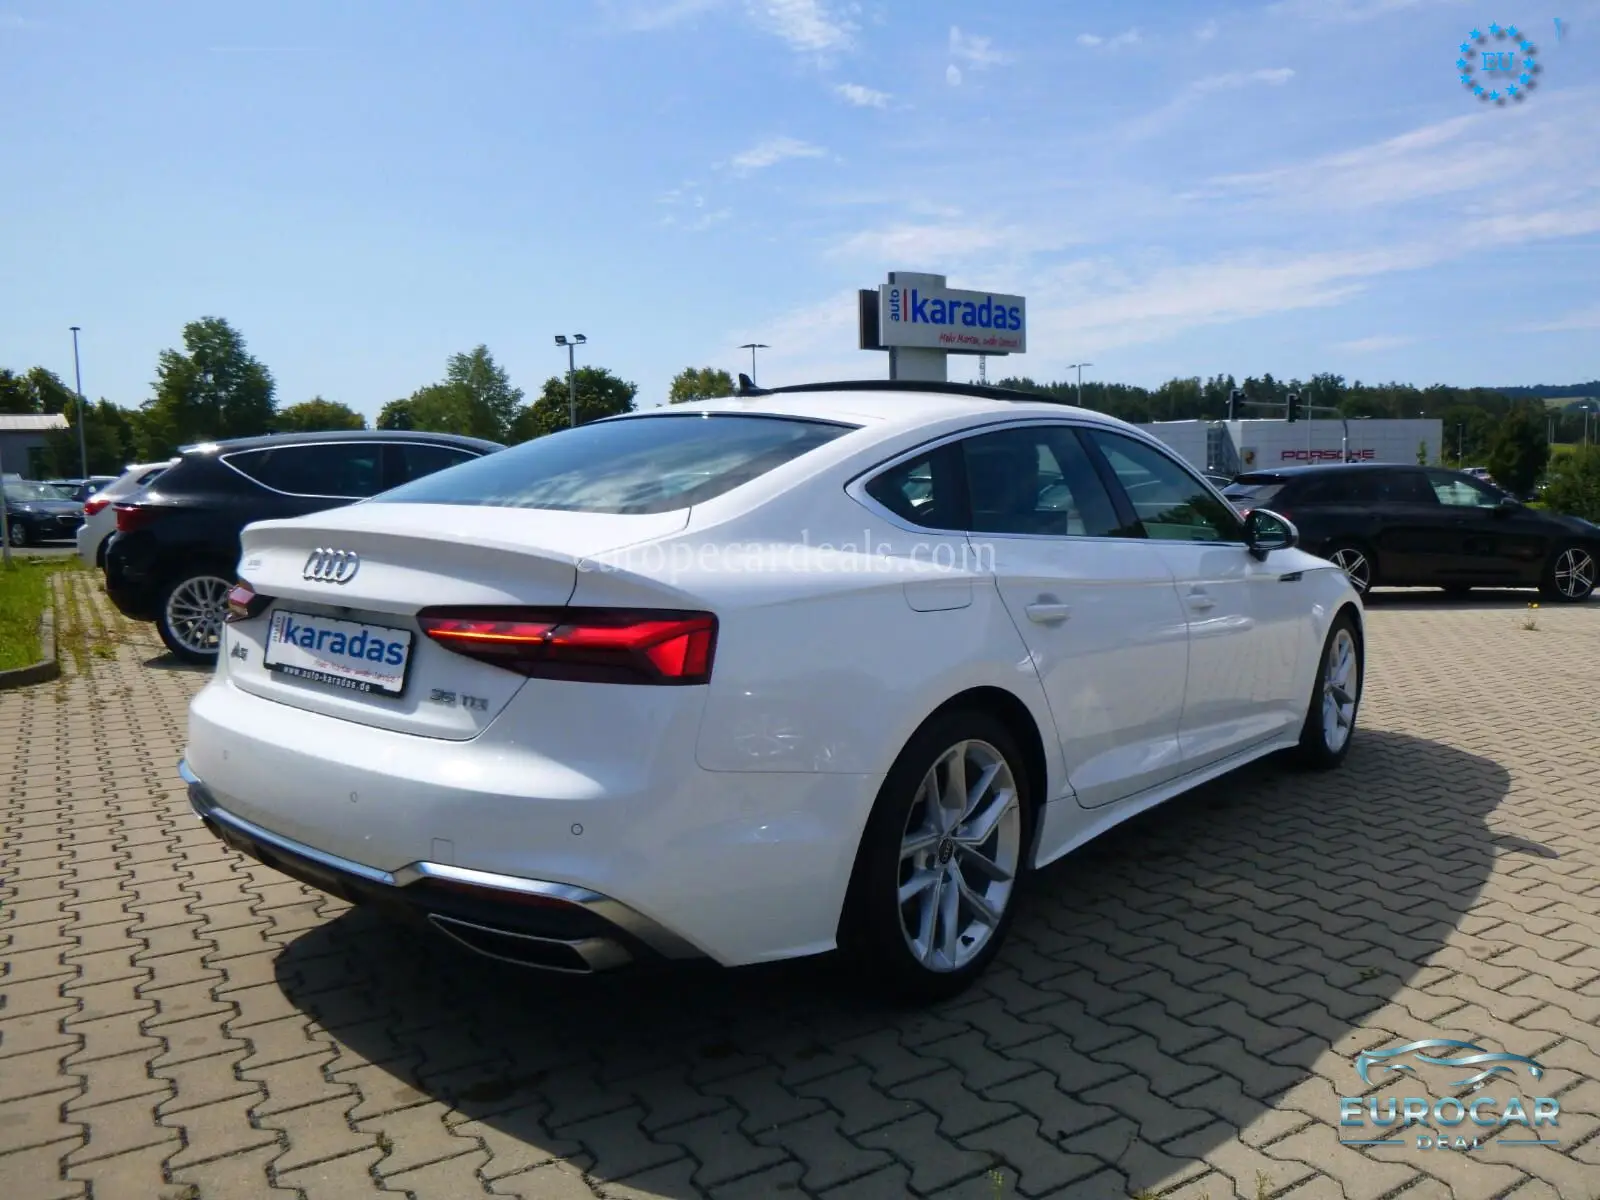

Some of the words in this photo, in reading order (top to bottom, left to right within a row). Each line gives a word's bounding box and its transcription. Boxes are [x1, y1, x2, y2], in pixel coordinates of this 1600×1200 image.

[889, 289, 900, 322] auto
[911, 288, 1021, 331] karadas
[1281, 449, 1376, 461] PORSCHE
[284, 617, 404, 666] karadas
[283, 666, 371, 692] www.auto-karadas.de
